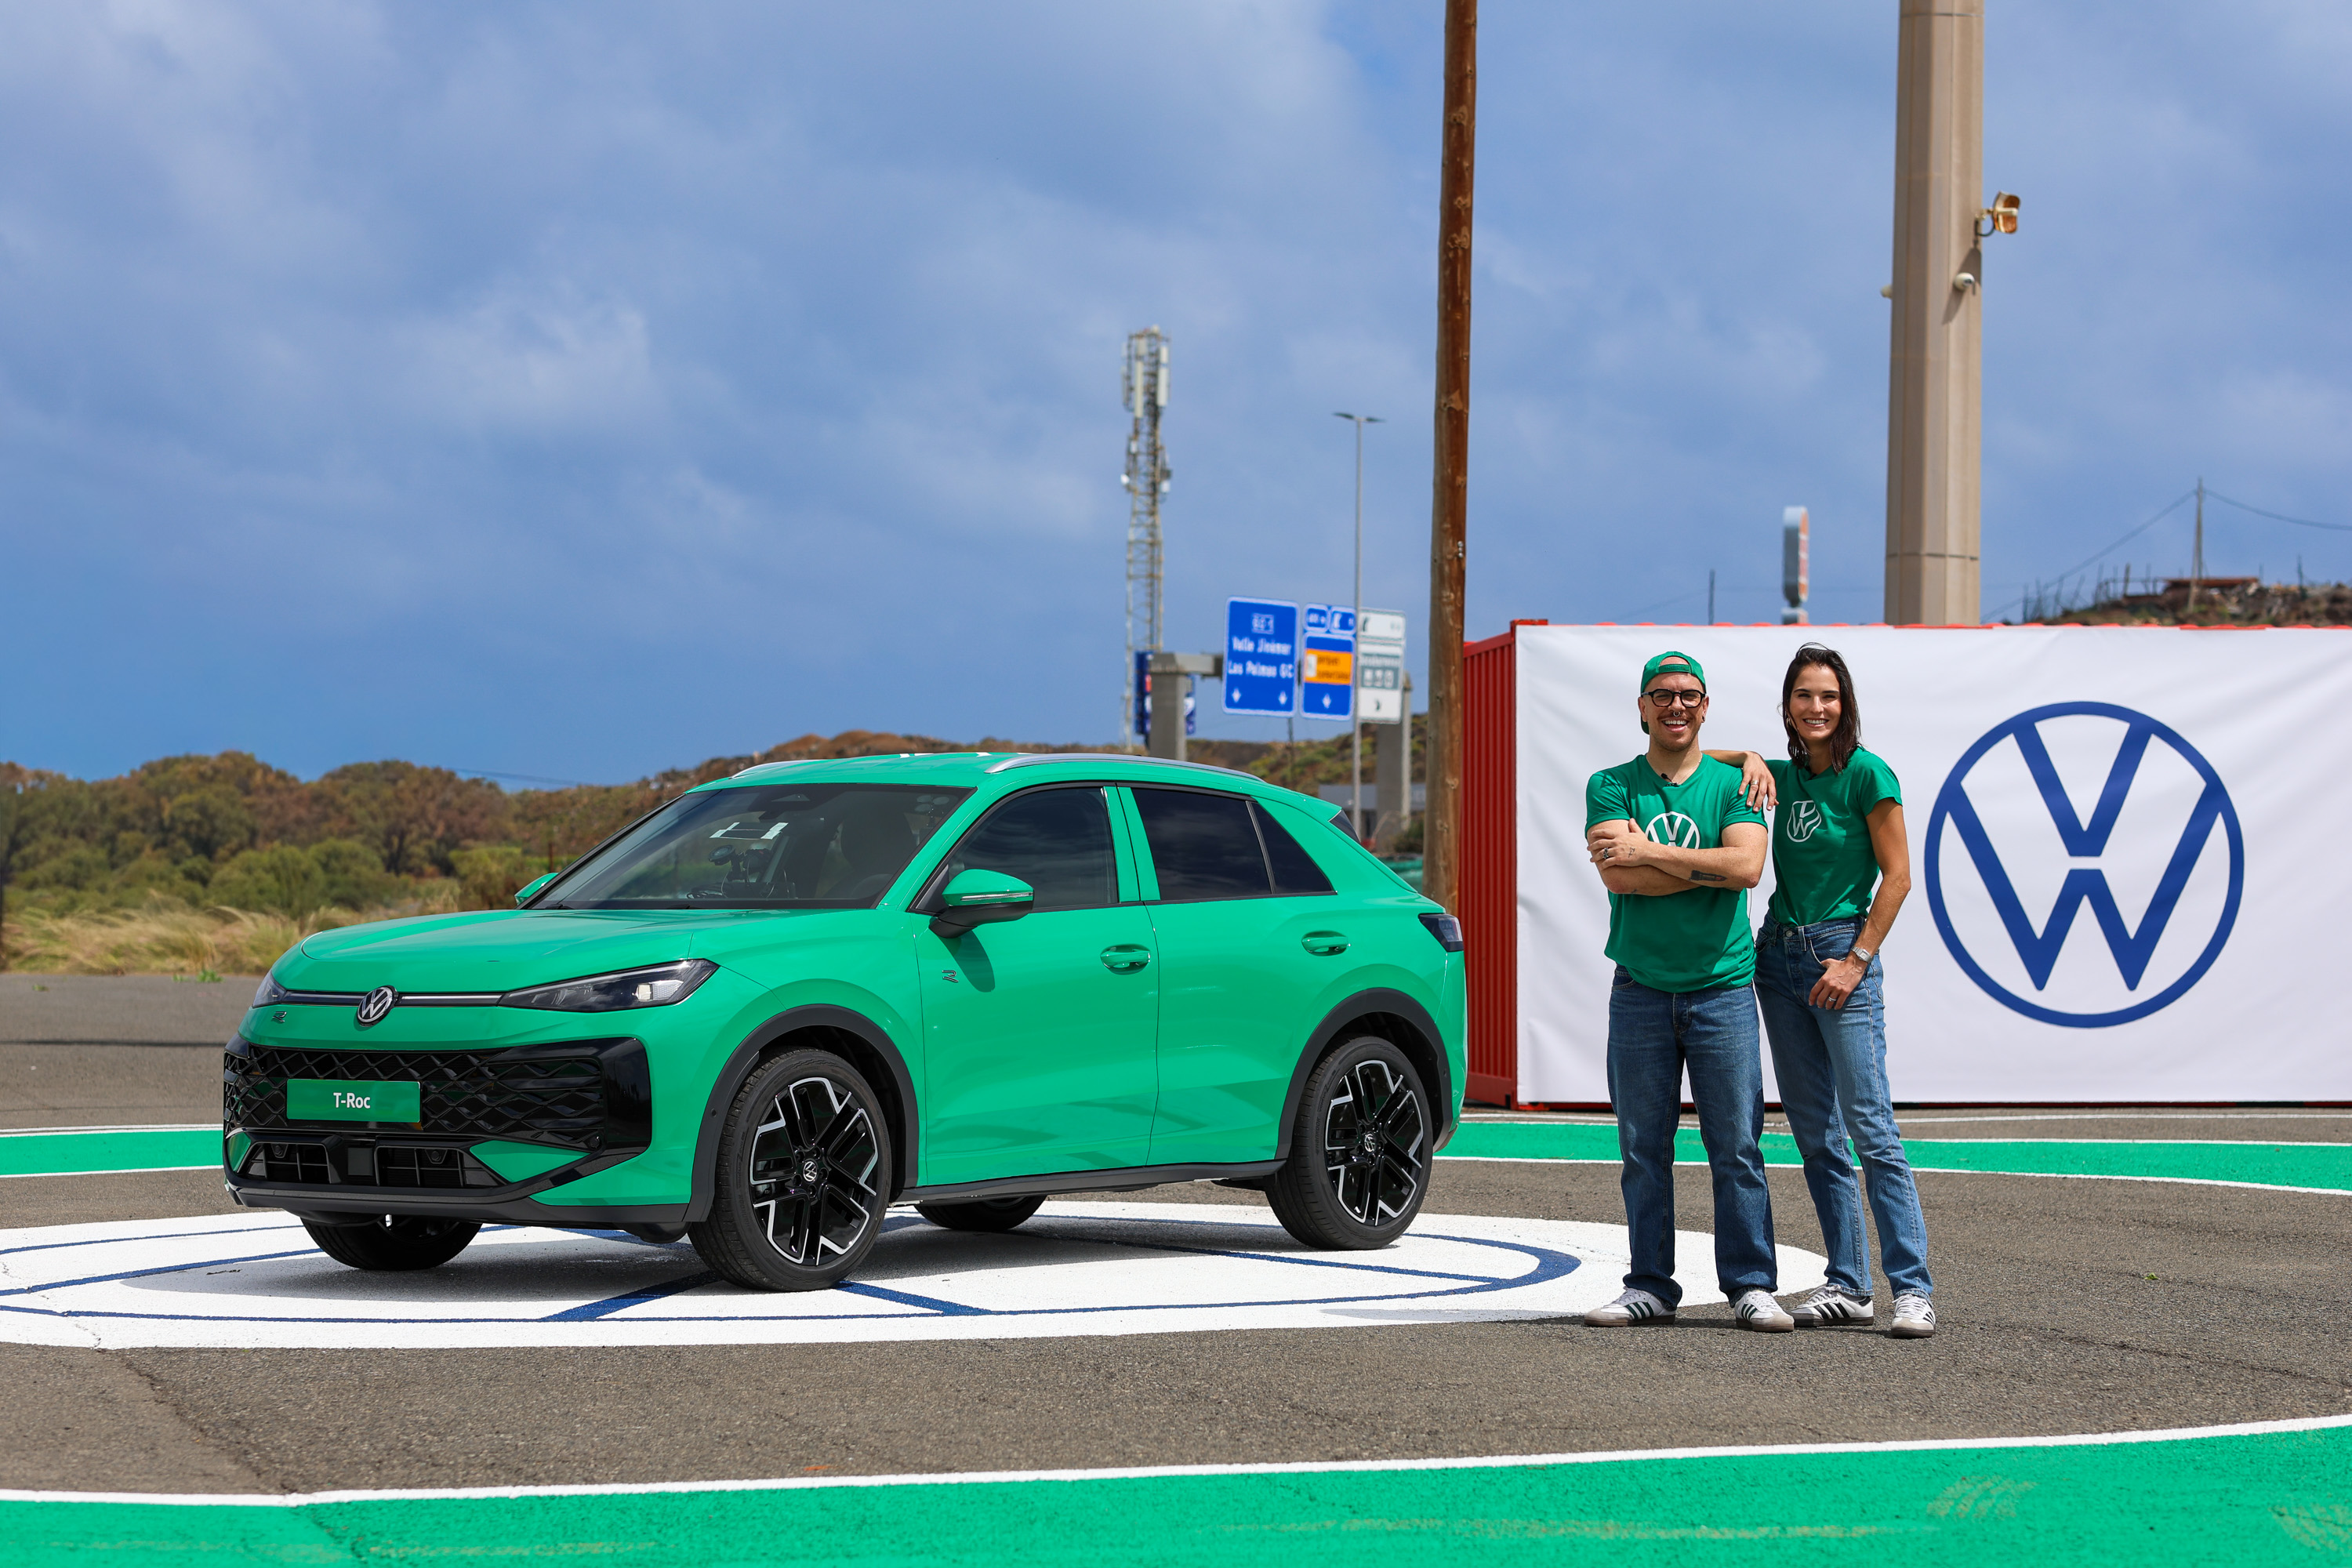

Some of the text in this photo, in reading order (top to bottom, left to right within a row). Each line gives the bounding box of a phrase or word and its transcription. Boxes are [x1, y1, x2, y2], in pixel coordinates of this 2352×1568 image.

[1232, 636, 1254, 652] Valle
[1228, 660, 1294, 679] Las Palmas GC
[333, 1092, 371, 1109] T-Roc
